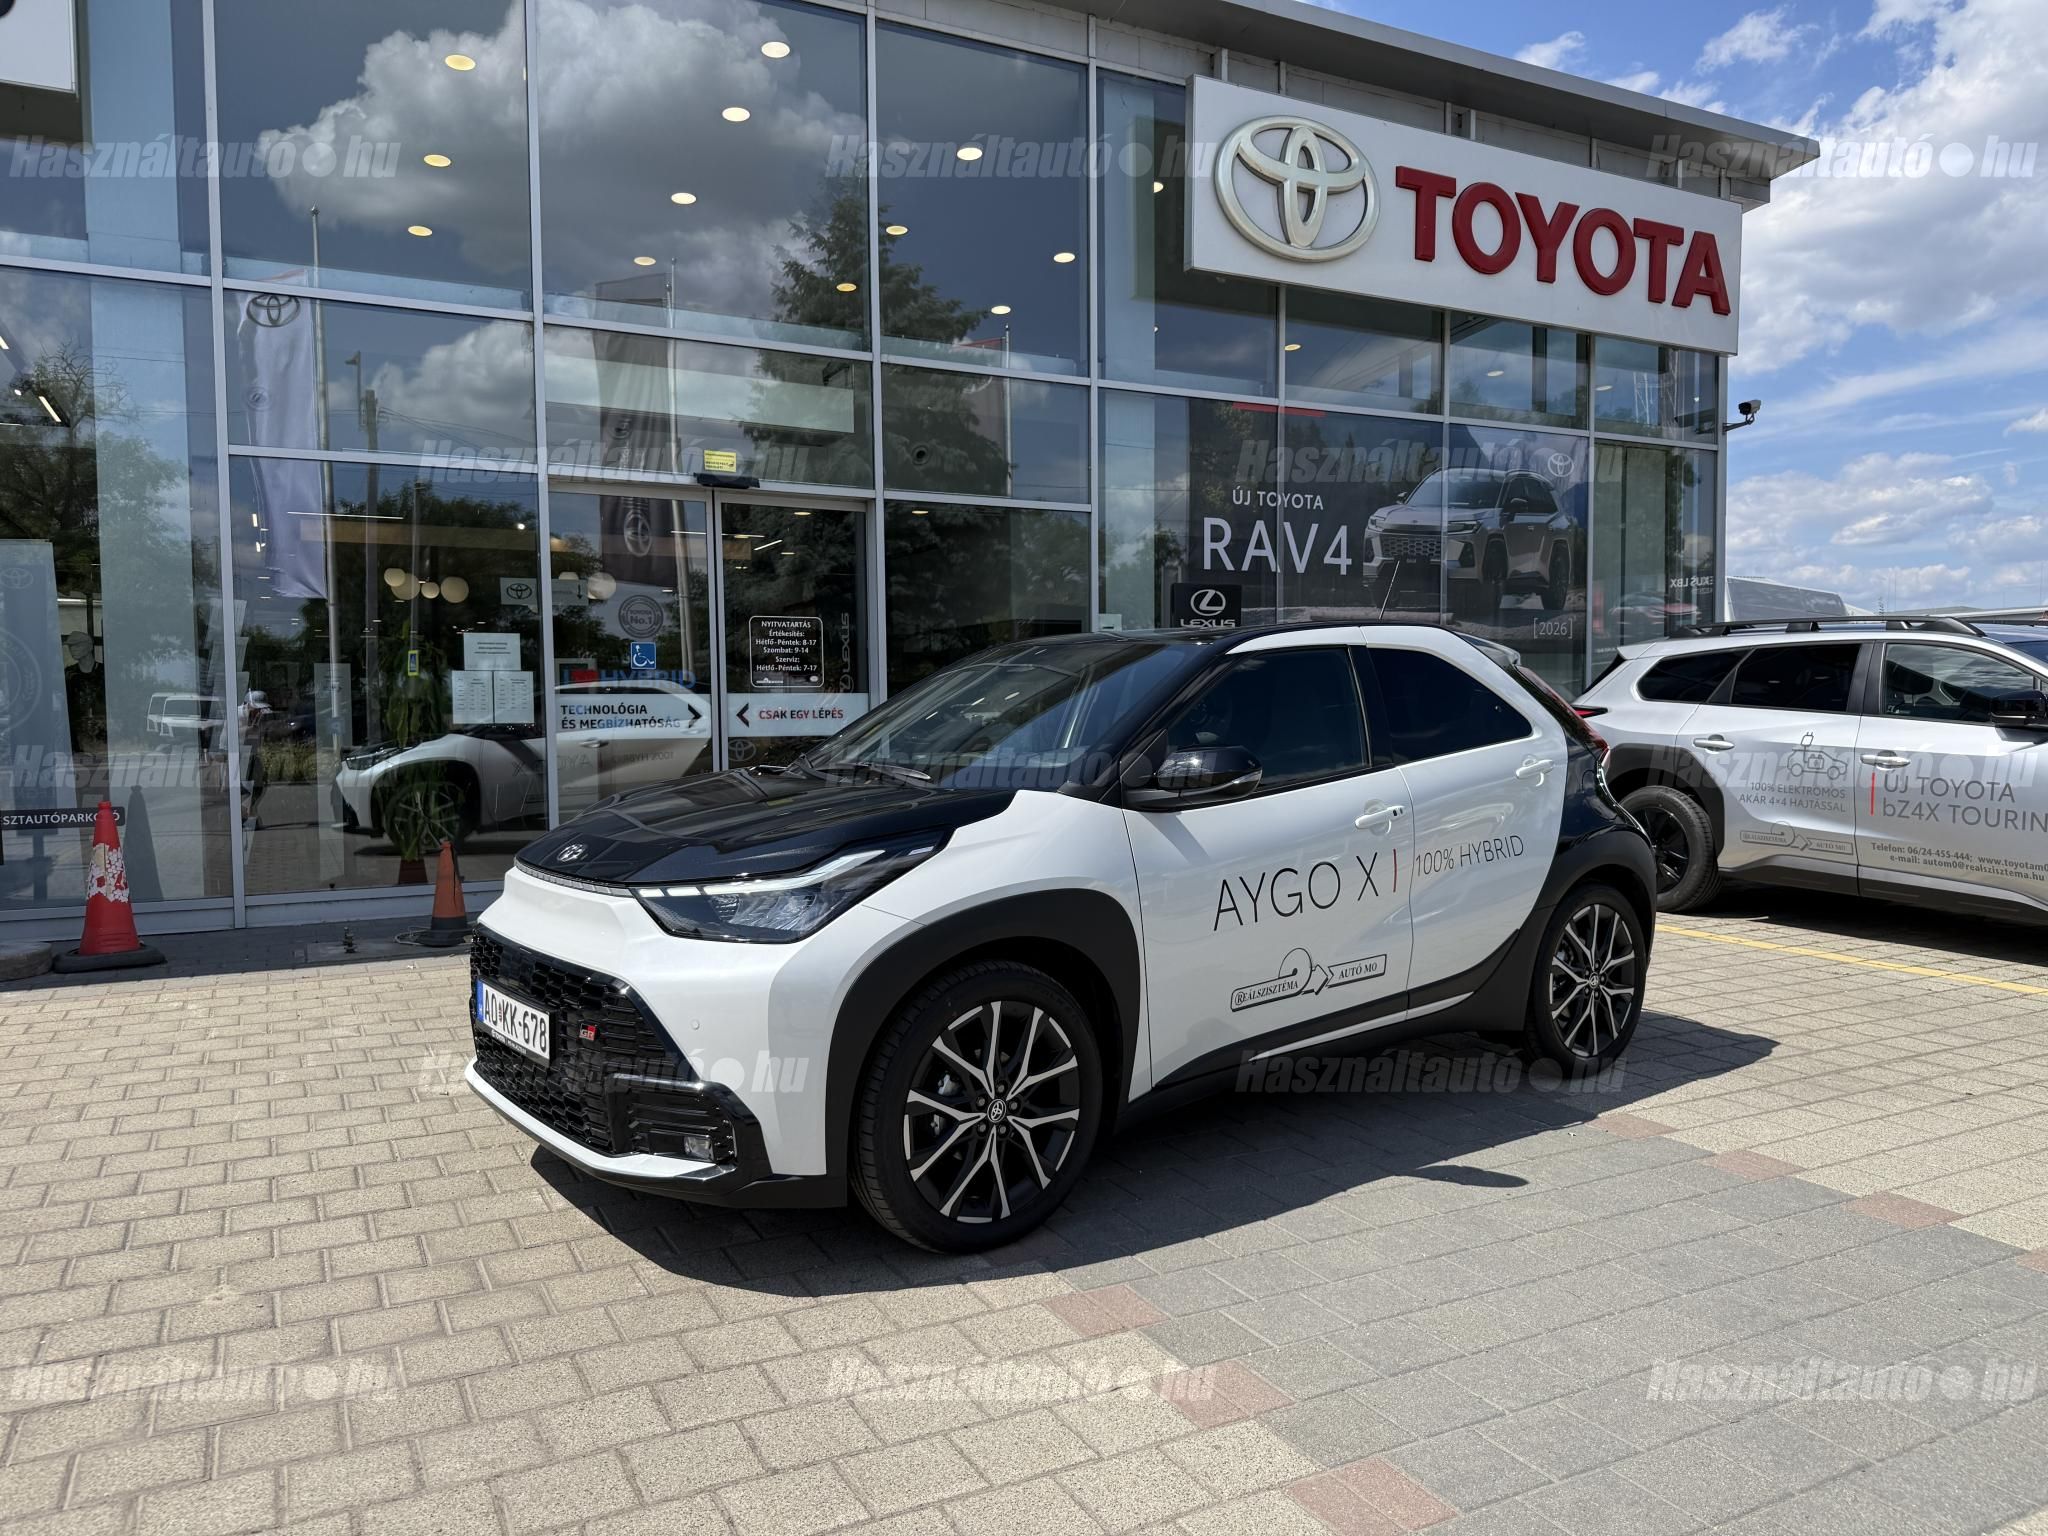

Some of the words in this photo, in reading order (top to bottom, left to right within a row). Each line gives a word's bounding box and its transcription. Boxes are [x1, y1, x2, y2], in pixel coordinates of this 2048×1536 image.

[1395, 165, 1731, 316] TOYOTA
[1232, 486, 1251, 506] ÚJ
[1257, 491, 1324, 511] TOYOTA
[1203, 517, 1352, 576] RAV4
[761, 620, 811, 628] NYITVATARTÁS
[1180, 618, 1236, 628] LEXUS
[763, 646, 793, 654] Szombat:
[841, 612, 850, 673] LEXUS
[600, 669, 697, 689] HYBRID
[560, 702, 648, 715] TECHNOLÓGIA
[759, 709, 788, 720] CSAK
[790, 709, 810, 720] EGY
[812, 707, 844, 720] LÉPÉS
[561, 717, 577, 729] ÉS
[580, 716, 681, 729] MEGBÍZHATÓSÁG
[1750, 781, 1775, 793] 100%
[1777, 783, 1846, 800] ELEKTROMOS
[1884, 769, 1909, 794] ÚJ
[1916, 776, 2016, 803] TOYOTA
[1740, 791, 1767, 805] AKÁR
[1883, 797, 1940, 822] bZ4X
[1947, 804, 2048, 833] TOURIN
[1415, 847, 1455, 876] 100%
[1459, 835, 1524, 867] HYBRID
[1871, 842, 1905, 854] Telefon:
[1889, 854, 1921, 865] e-mail:
[1213, 861, 1341, 932] AYGO
[1356, 851, 1380, 901] X
[1339, 962, 1363, 979] AUTÓ
[580, 1028, 595, 1041] GR
